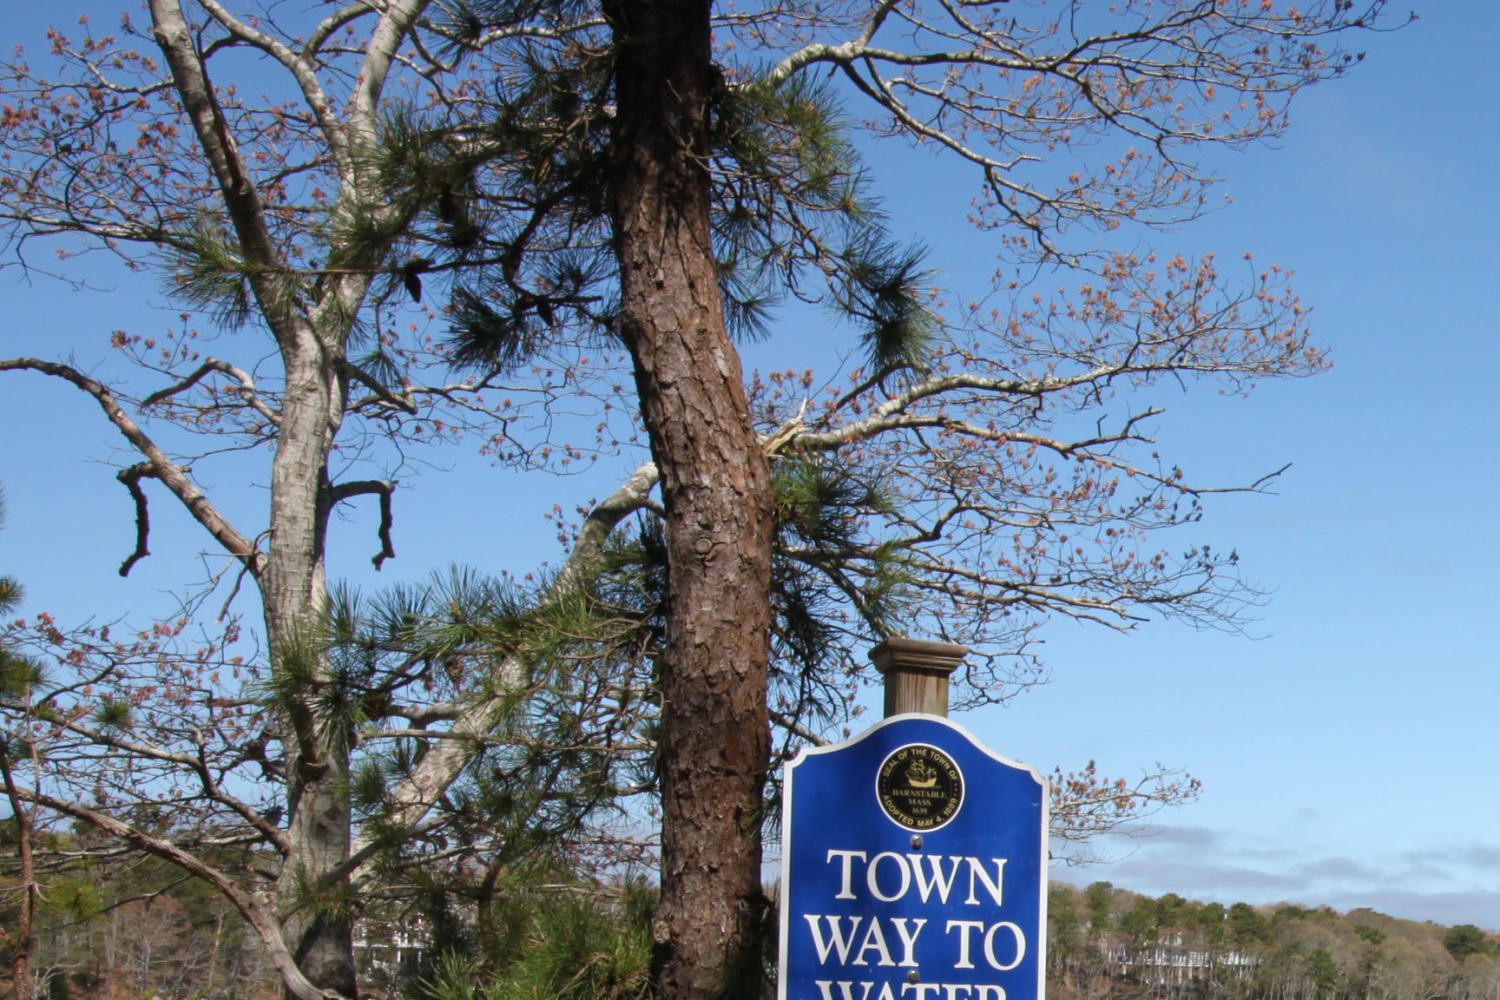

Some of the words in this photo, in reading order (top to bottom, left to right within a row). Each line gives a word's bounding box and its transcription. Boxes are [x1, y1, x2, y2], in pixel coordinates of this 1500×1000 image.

[883, 758, 898, 777] SEAL
[898, 750, 909, 760] OF
[911, 748, 928, 756] THE
[930, 751, 951, 770] TOWN
[950, 769, 958, 780] OF
[892, 789, 945, 799] BARNSTABLE
[883, 795, 914, 826] ADOPTED
[917, 819, 934, 827] MAY
[826, 849, 1008, 907] TOWN
[803, 913, 928, 968] WAY
[945, 919, 1026, 972] TO
